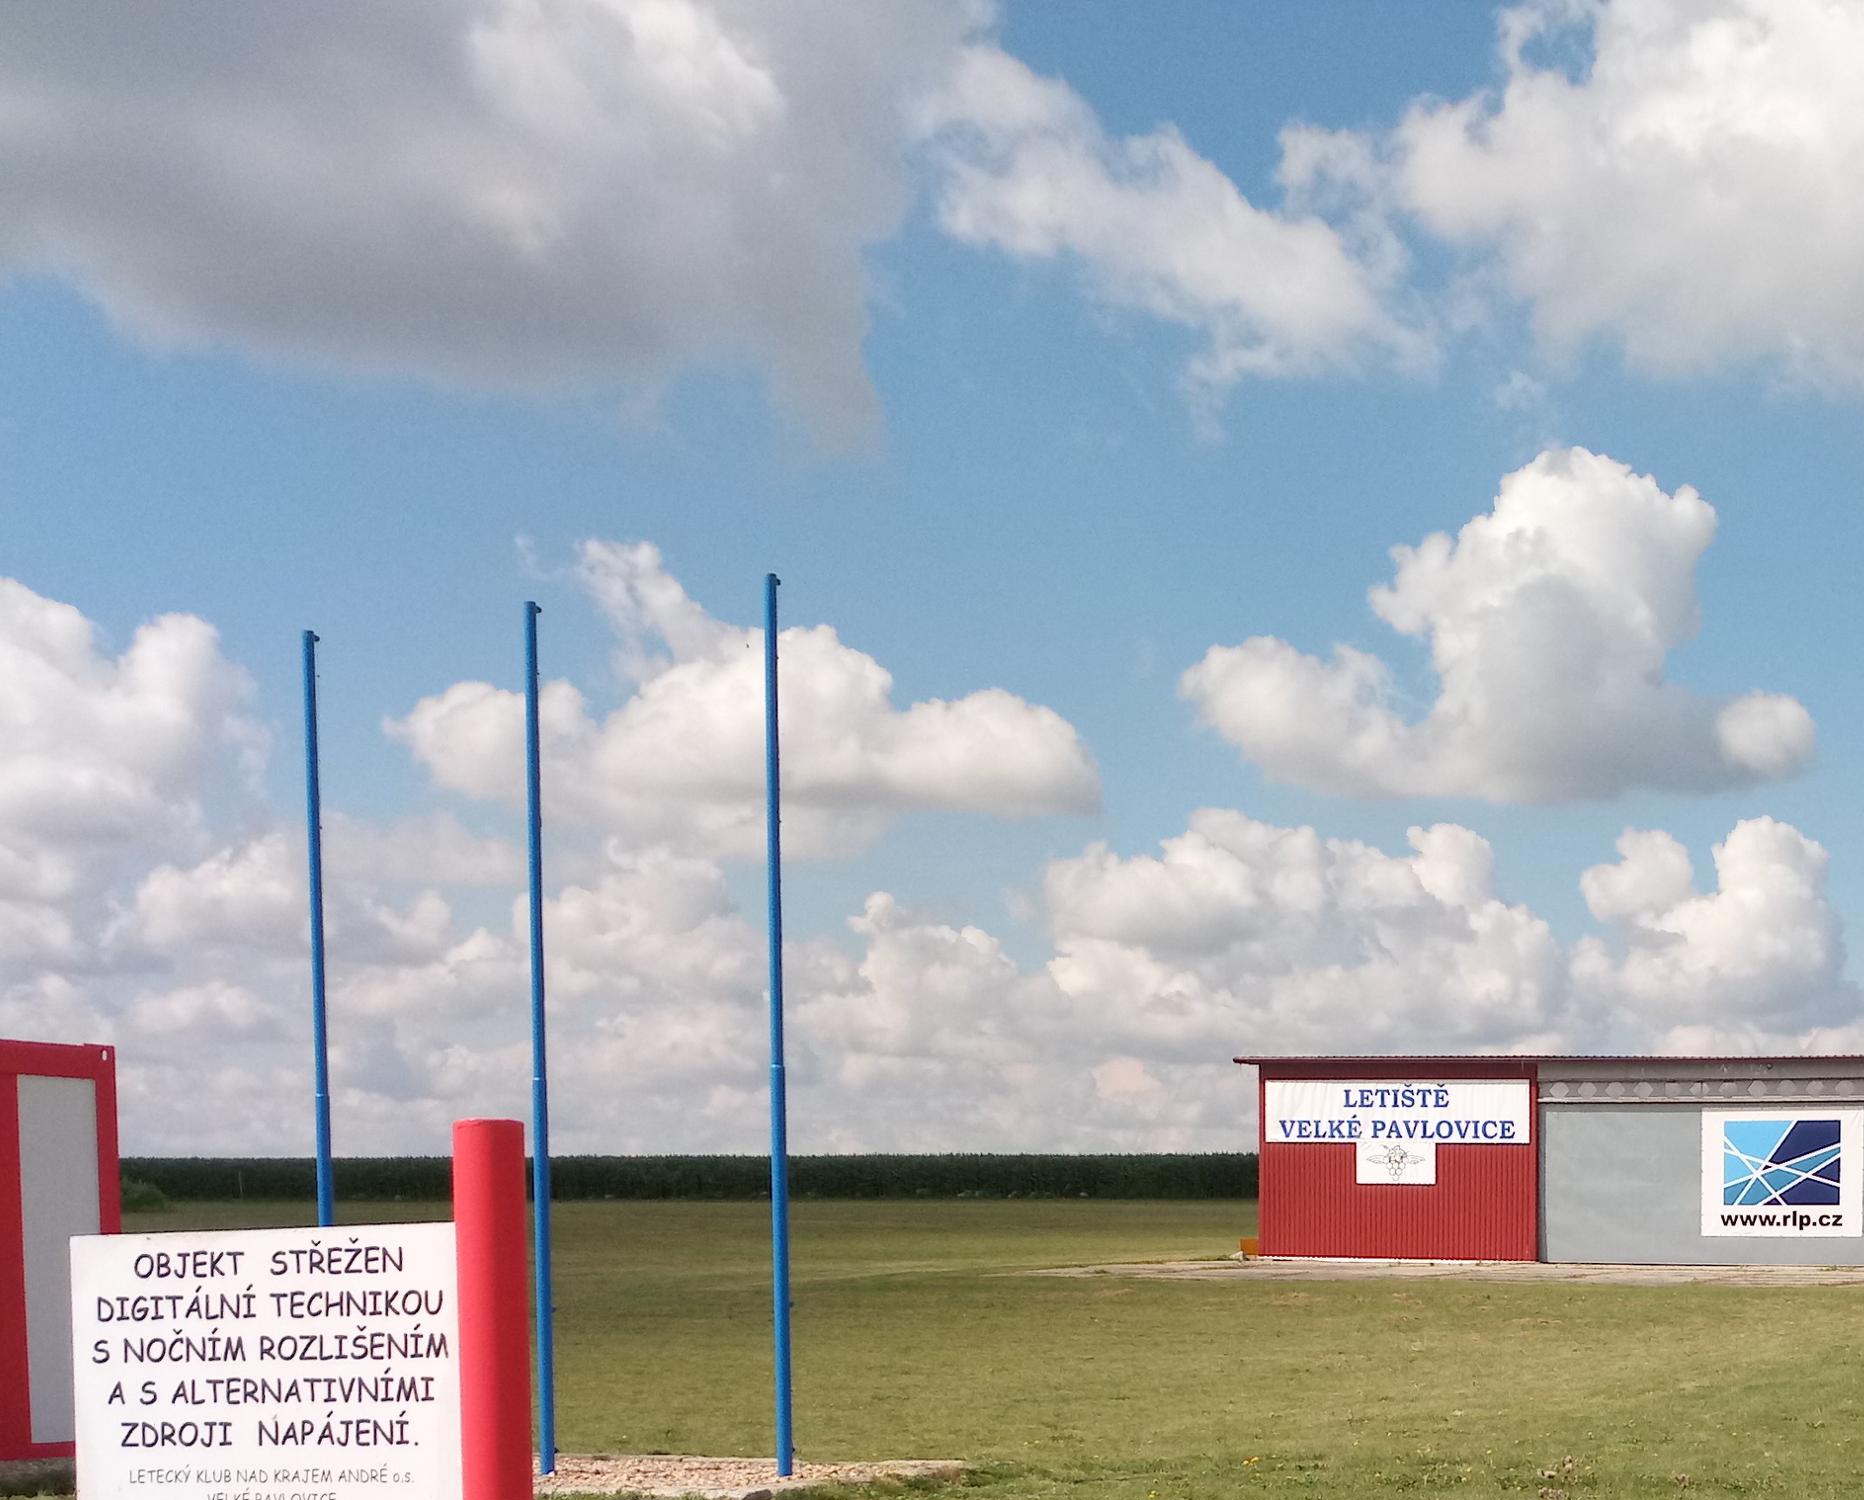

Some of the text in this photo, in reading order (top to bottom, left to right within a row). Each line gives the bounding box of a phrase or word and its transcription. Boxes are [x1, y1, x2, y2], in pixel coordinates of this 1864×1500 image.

[1343, 1083, 1450, 1108] LETIŠTĚ
[1279, 1114, 1516, 1140] VELKÉ PAVLOVICE
[1720, 1209, 1843, 1231] www.rlp.cz
[133, 1238, 403, 1279] OBJEKT STŘEŽEN
[97, 1284, 443, 1322] DIGITÁLNÍ TECHNIKOU
[91, 1324, 449, 1365] S NOČNÍM ROZLIŠENÍM
[108, 1368, 435, 1405] A S ALTERNATIVNÍMI
[121, 1410, 420, 1448] ZDROJI NAPÁJENÍ.
[129, 1464, 191, 1484] LETECKÝ
[196, 1470, 232, 1484] KLUB
[236, 1470, 268, 1483] NAD
[274, 1469, 333, 1483] KRAJEM
[338, 1463, 388, 1483] ANDRÉ
